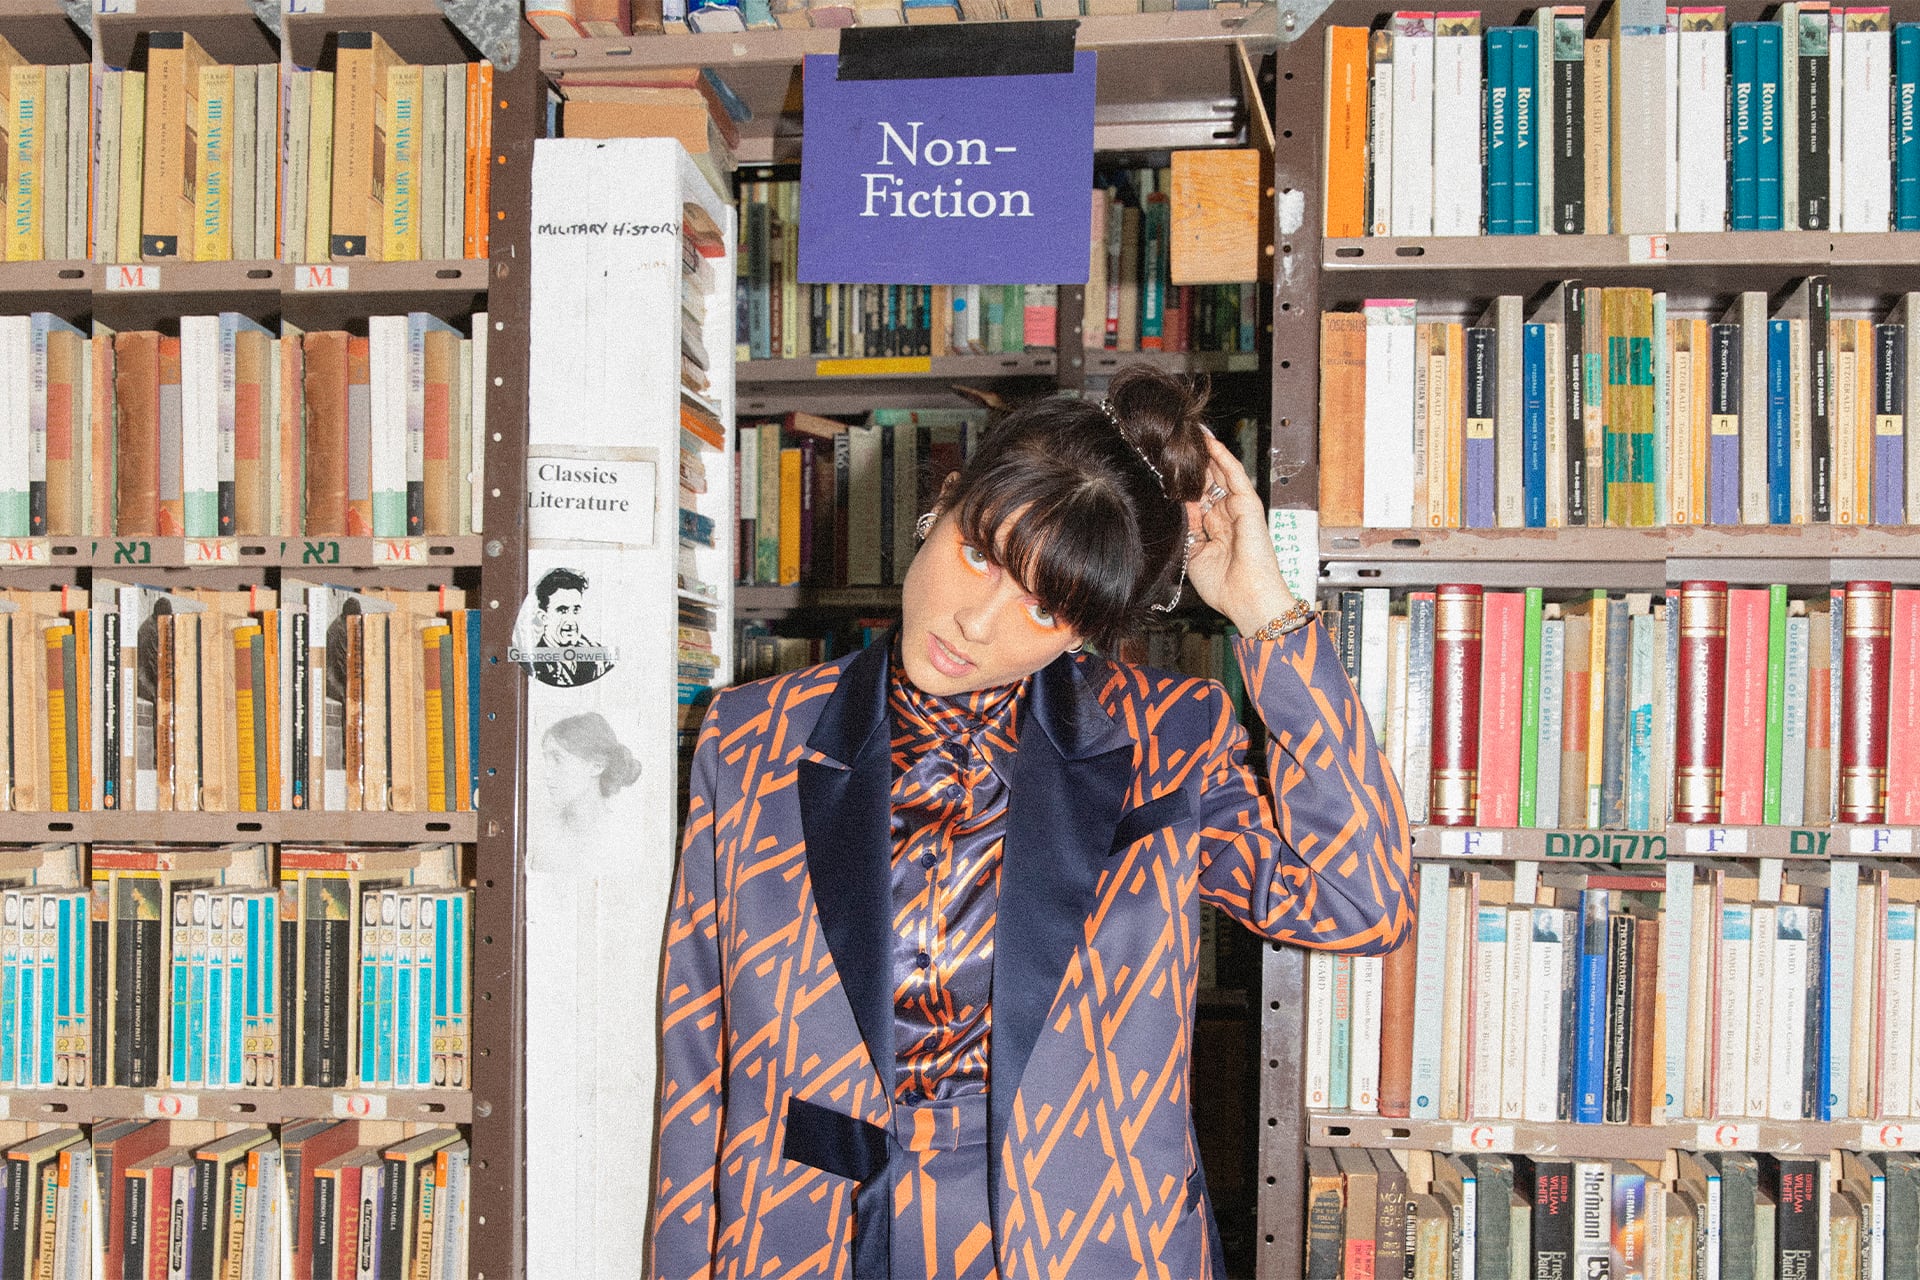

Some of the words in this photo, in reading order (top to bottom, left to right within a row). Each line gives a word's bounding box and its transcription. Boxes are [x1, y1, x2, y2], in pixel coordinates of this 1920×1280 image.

[19, 97, 34, 122] THE
[207, 97, 222, 122] THE
[396, 97, 411, 122] THE
[1492, 87, 1507, 148] ROMOLA
[1517, 87, 1531, 149] ROMOLA
[1566, 115, 1572, 125] ON
[1737, 83, 1752, 144] ROMOLA
[1762, 83, 1776, 145] ROMOLA
[1901, 83, 1916, 144] ROMOLA
[19, 128, 34, 163] MAGIC
[207, 128, 222, 163] MAGIC
[396, 128, 411, 163] MAGIC
[878, 122, 1016, 166] Non-
[394, 171, 410, 235] MOUNTAIN
[860, 174, 1034, 218] Fiction
[538, 222, 608, 236] MILITARY
[120, 267, 145, 288] M
[308, 267, 334, 288] M
[1417, 367, 1425, 400] JONATHAN
[1417, 403, 1425, 419] WILD
[538, 464, 618, 484] Classics
[527, 492, 629, 512] Literature
[8, 543, 34, 560] M
[114, 542, 151, 564] נא
[196, 543, 223, 560] M
[302, 542, 340, 564] נא
[386, 543, 412, 560] M
[1348, 611, 1354, 622] M.
[1349, 600, 1355, 608] E.
[510, 648, 560, 661] GEORGE
[1545, 626, 1553, 681] QUERELLE
[1462, 832, 1482, 854] F
[1707, 829, 1726, 851] F
[1872, 829, 1891, 851] F
[1470, 1126, 1495, 1148] G
[1716, 1124, 1739, 1147] G
[1880, 1124, 1904, 1147] G
[1391, 1182, 1397, 1191] A
[1538, 1175, 1548, 1205] WHITE
[1550, 1175, 1558, 1215] WILLIAM
[1783, 1172, 1793, 1202] WHITE
[1795, 1172, 1803, 1212] WILLIAM
[1584, 1172, 1604, 1238] Hermann
[1626, 1189, 1635, 1232] HERMANN
[1625, 1234, 1634, 1261] HESSE
